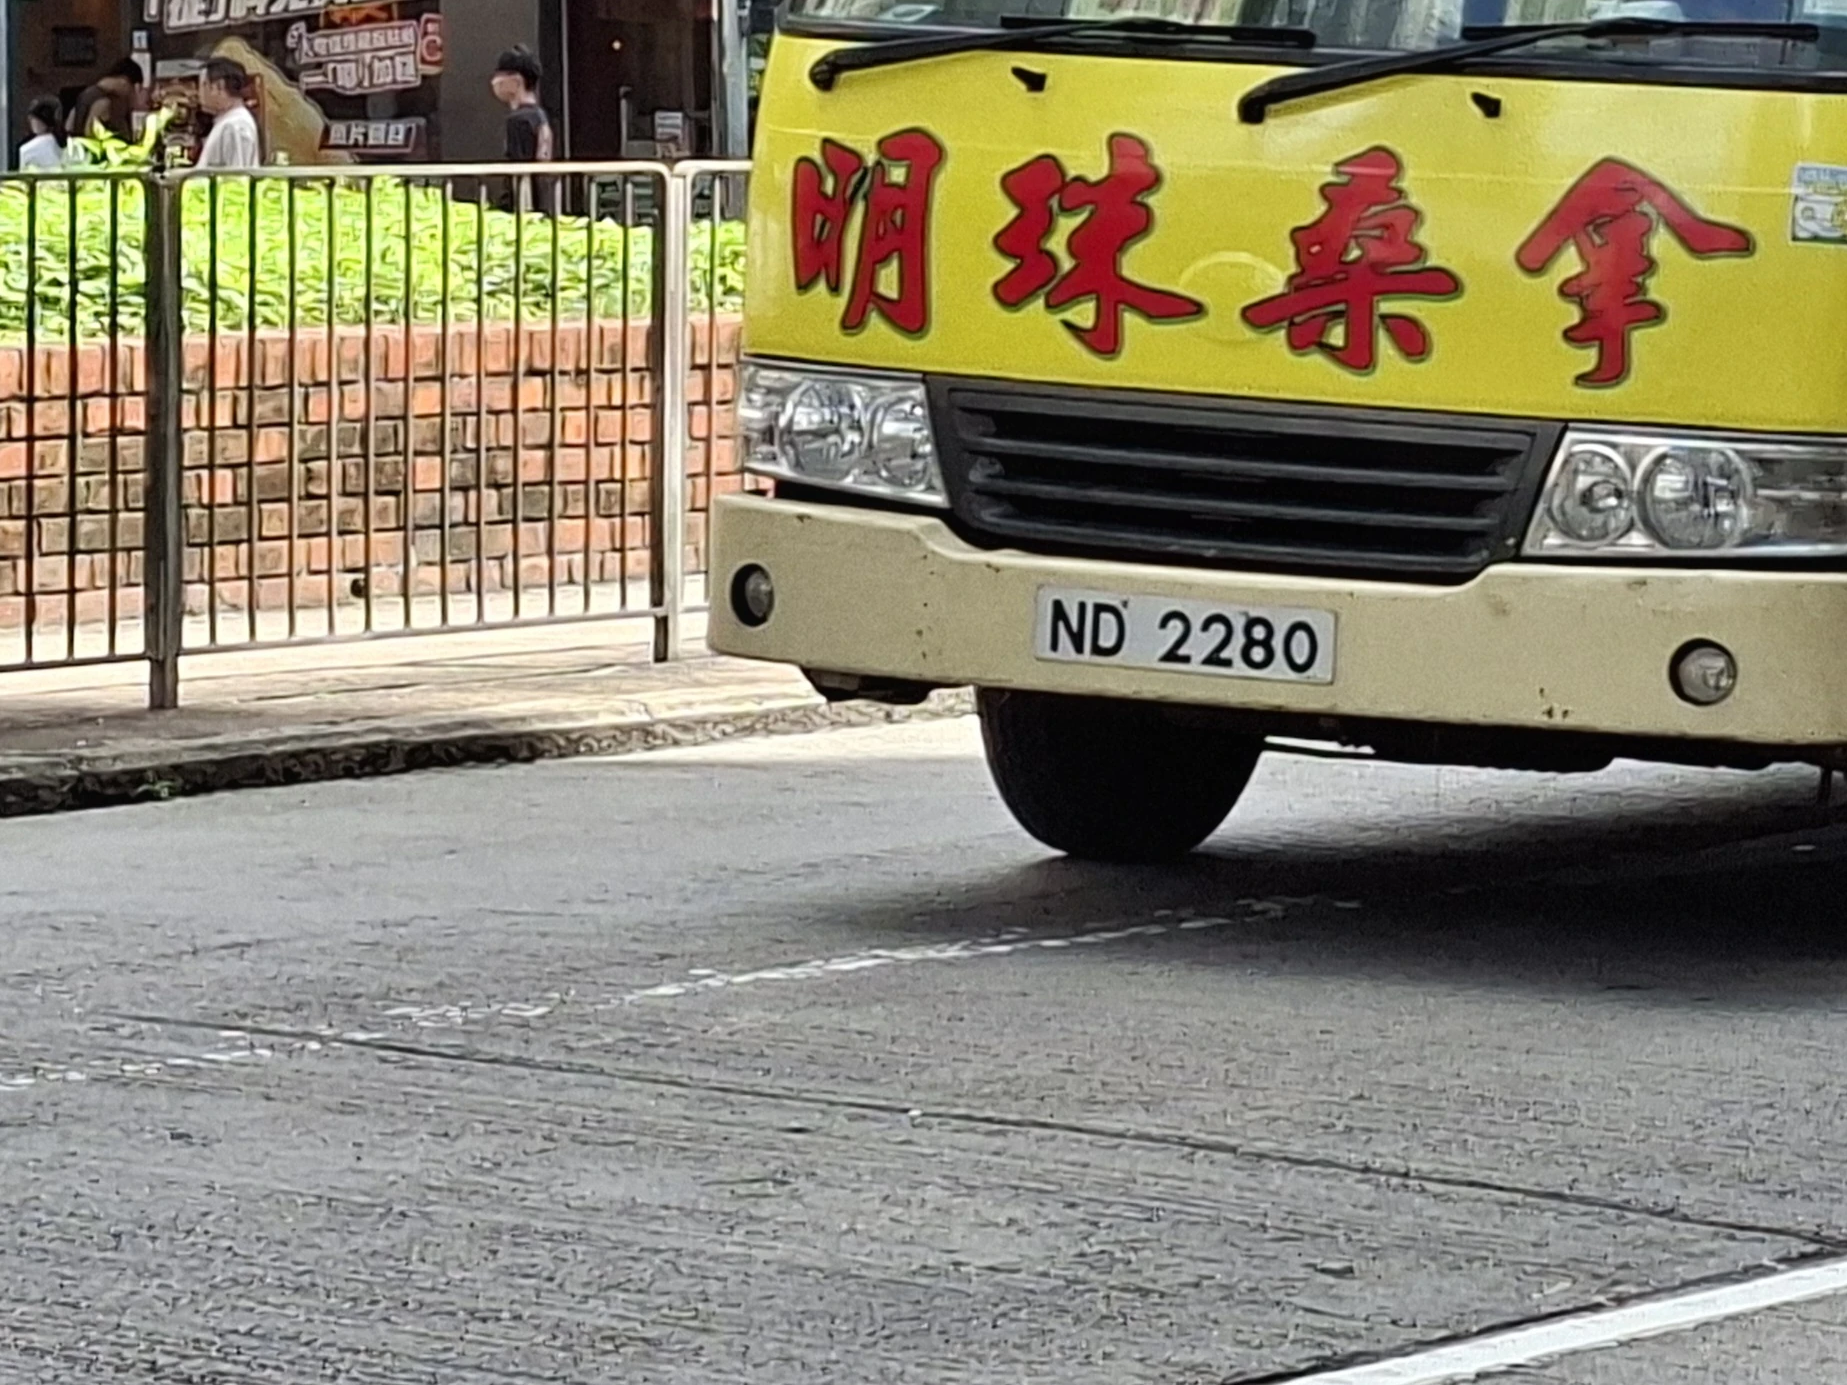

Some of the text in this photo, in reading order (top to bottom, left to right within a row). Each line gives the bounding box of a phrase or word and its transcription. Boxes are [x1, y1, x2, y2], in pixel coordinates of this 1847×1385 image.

[790, 126, 1756, 388] 明珠桑拿
[1050, 598, 1318, 673] ND 2280
